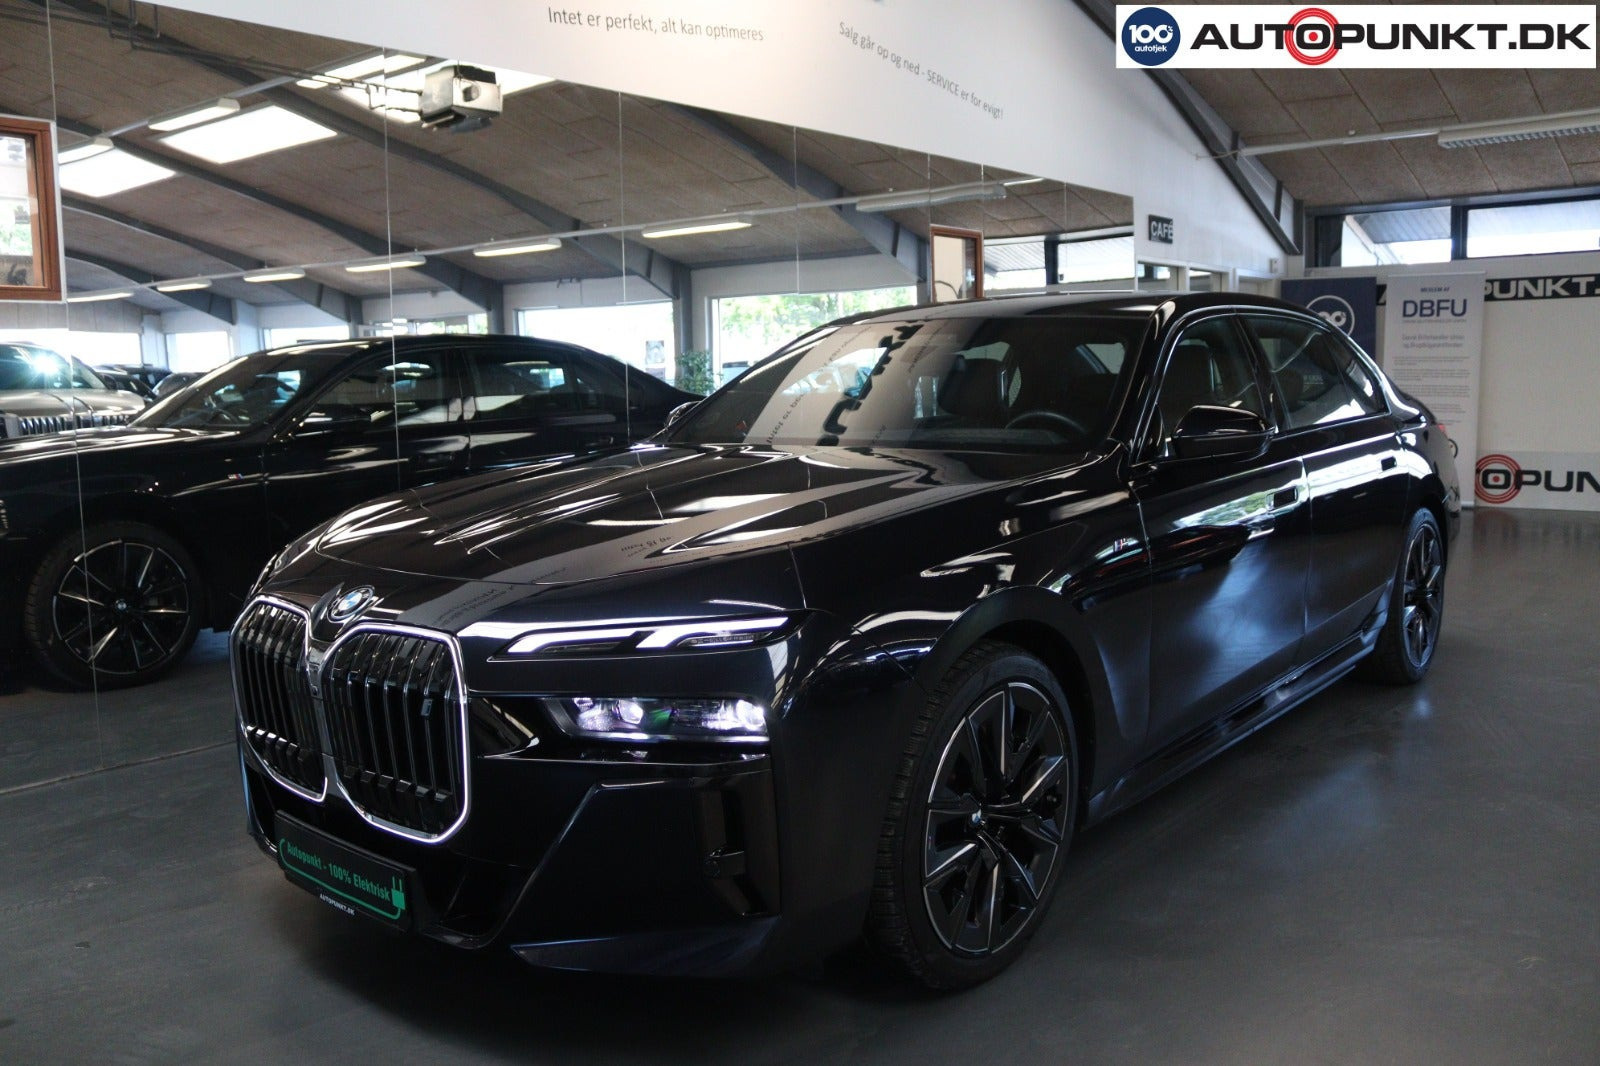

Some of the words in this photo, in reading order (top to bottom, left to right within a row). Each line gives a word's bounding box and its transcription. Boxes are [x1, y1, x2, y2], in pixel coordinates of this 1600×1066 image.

[548, 6, 583, 26] Intet
[587, 13, 601, 27] er
[605, 13, 658, 35] perfekt,
[661, 17, 678, 34] alt
[680, 18, 703, 36] kan
[705, 23, 765, 41] optimeres
[839, 21, 859, 45] Salg
[860, 35, 875, 50] går
[877, 45, 889, 60] op
[890, 53, 902, 69] og
[903, 59, 920, 75] ned
[927, 69, 960, 96] SERVICE
[960, 89, 969, 102] er
[970, 92, 982, 108] for
[983, 101, 1004, 120] evigt!
[1402, 299, 1467, 318] DBFU
[287, 841, 322, 870] Autopunkt
[329, 863, 352, 884] 100%
[353, 872, 391, 902] Elektrisk
